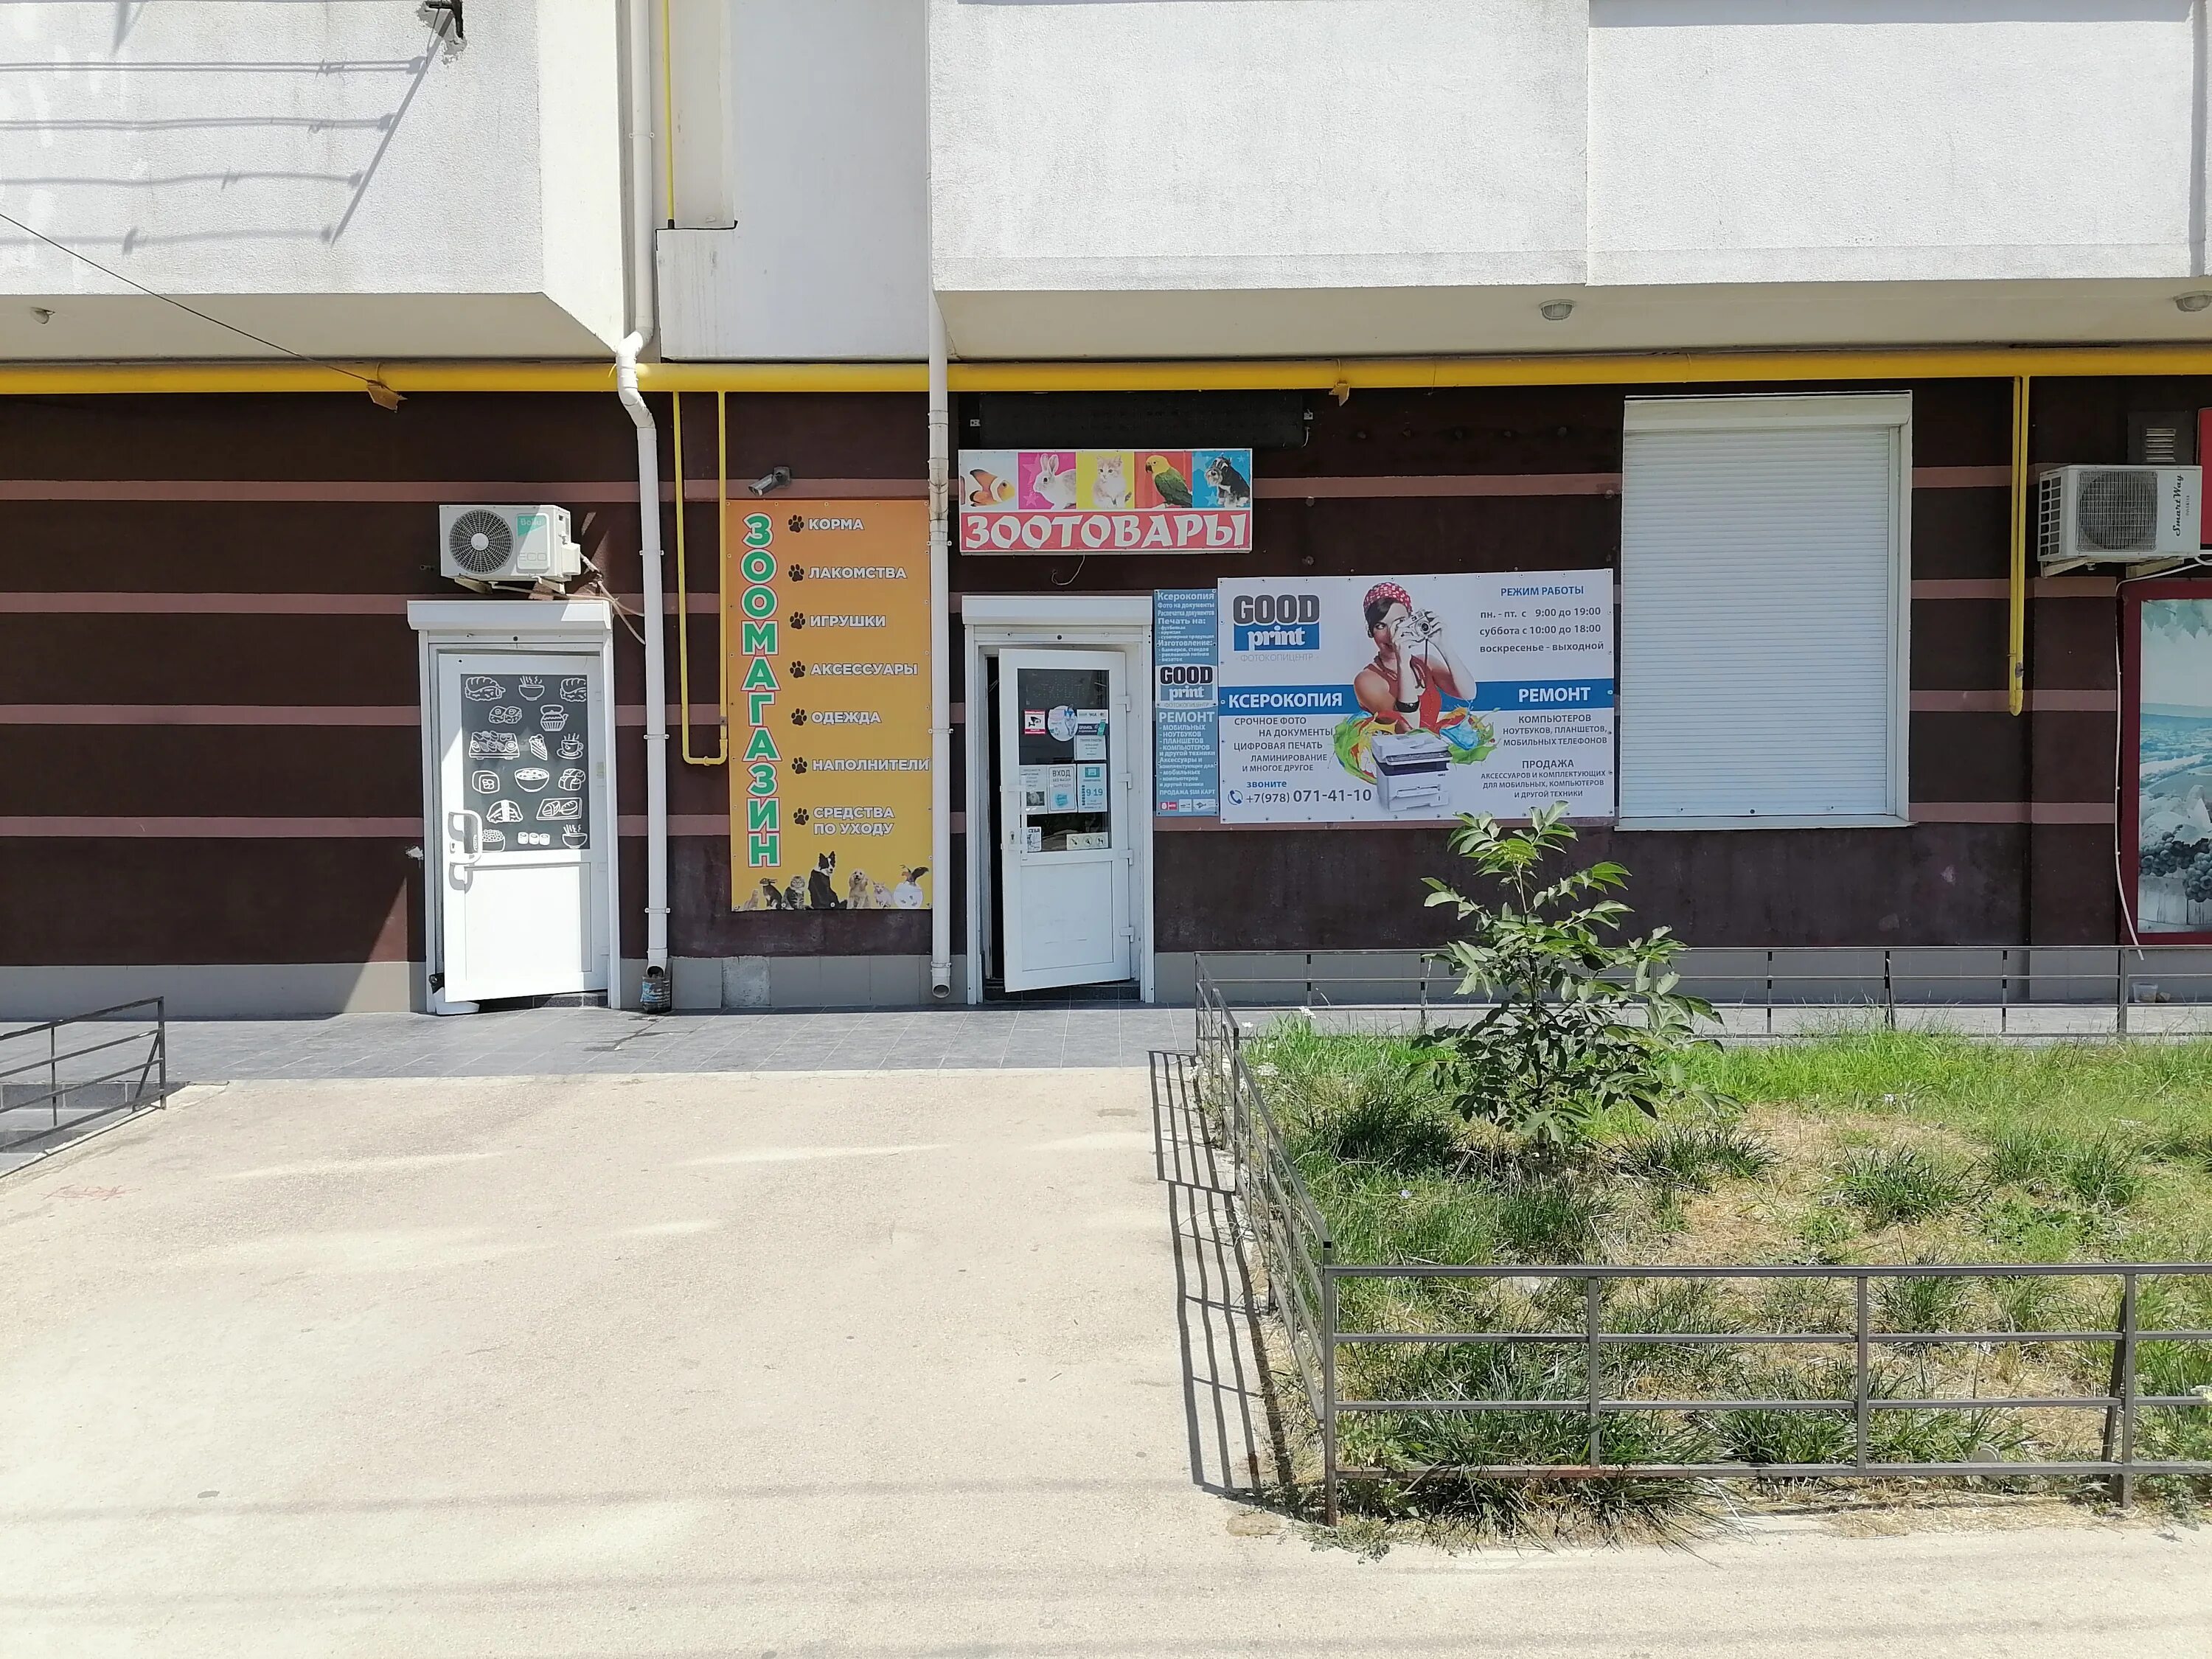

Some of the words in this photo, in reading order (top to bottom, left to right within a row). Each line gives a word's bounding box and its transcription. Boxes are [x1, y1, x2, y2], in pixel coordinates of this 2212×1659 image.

[808, 518, 865, 530] КОРМА
[965, 514, 1247, 549] ЗООТОВАРЫ
[808, 567, 908, 579] ЛАКОМСТВА
[1500, 587, 1539, 597] РЕЖИМ
[1542, 585, 1584, 595] РАБОТЫ
[1158, 593, 1214, 602] Ксерокопия
[1233, 594, 1320, 624] GOOD
[1535, 609, 1556, 617] 9:00
[1559, 609, 1571, 618] до
[1573, 608, 1601, 616] 19:00
[810, 616, 886, 627] ИГРУШКИ
[1248, 625, 1306, 650] print
[1480, 626, 1520, 638] суббота
[1529, 626, 1556, 634] 10:00
[1559, 626, 1571, 635] до
[1574, 625, 1601, 633] 18:00
[1480, 643, 1544, 654] воскресенье
[1552, 641, 1604, 652] выходной
[1240, 653, 1313, 662] ФОТОКОПИЦЕНТР
[810, 664, 918, 675] АКСЕССУАРЫ
[1160, 667, 1213, 684] GOOD
[740, 512, 782, 867] ЗООМАГАЗИН
[1169, 686, 1204, 700] print
[1518, 687, 1590, 702] РЕМОНТ
[1228, 693, 1343, 709] КСЕРОКОПИЯ
[811, 712, 881, 725] ОДЕЖДА
[1159, 712, 1214, 723] РЕМОНТ
[1234, 717, 1278, 726] СРОЧНОЕ
[1280, 717, 1307, 725] ФОТО
[1518, 714, 1591, 723] КОМПЬЮТЕРОВ
[1259, 728, 1272, 737] НА
[1274, 728, 1334, 738] ДОКУМЕНТЫ
[1503, 727, 1553, 735] НОУТБУКОВ,
[1234, 742, 1285, 751] ЦИФРОВАЯ
[1503, 738, 1557, 746] МОБИЛЬНЫХ
[1251, 754, 1327, 762] ЛАМИНИРОВАНИЕ
[813, 759, 930, 771] НАПОЛНИТЕЛИ
[1284, 765, 1313, 773] ДРУГОЕ
[1522, 760, 1574, 770] ПРОДАЖА
[1246, 793, 1290, 803] +7(978)
[1293, 789, 1371, 802] 071-41-10
[1521, 790, 1548, 799] ДРУГОЙ
[813, 807, 895, 820] СРЕДСТВА
[813, 824, 836, 835] ПО
[840, 824, 894, 836] УХОДУ
